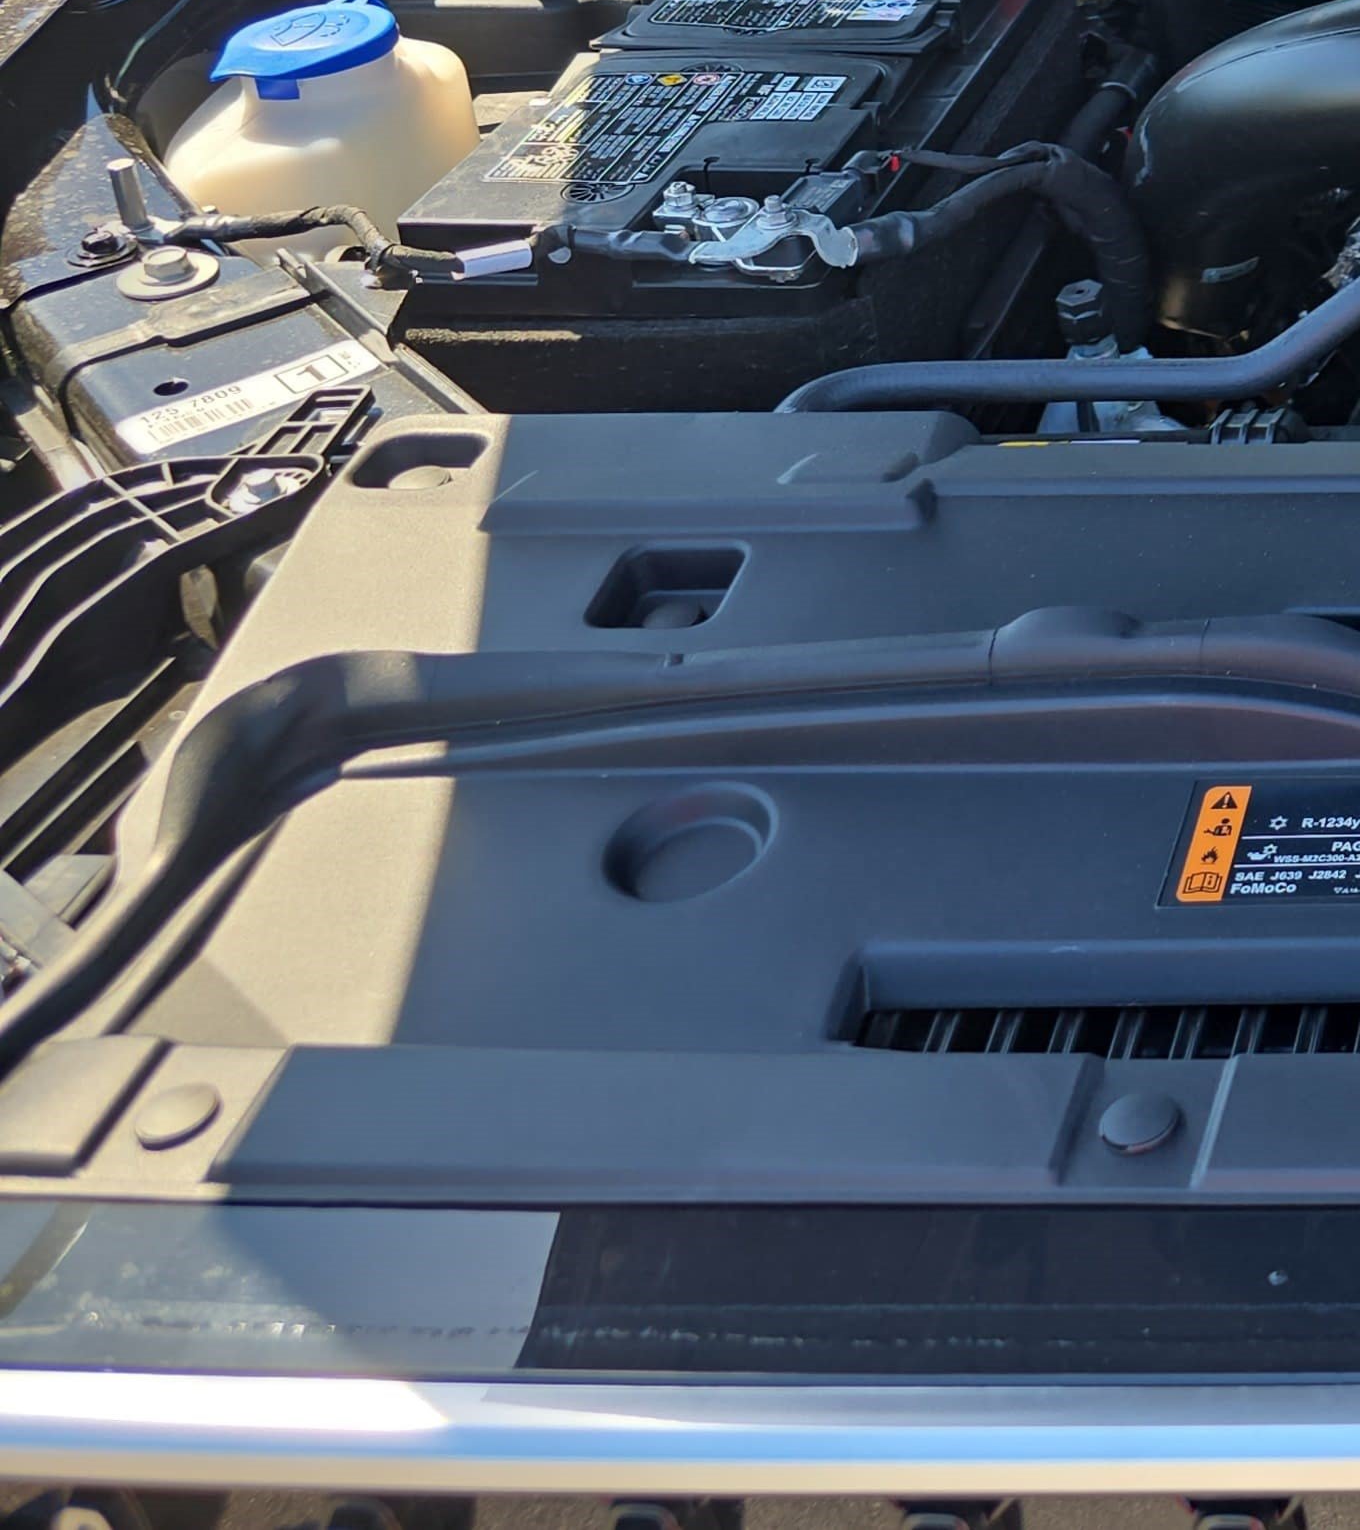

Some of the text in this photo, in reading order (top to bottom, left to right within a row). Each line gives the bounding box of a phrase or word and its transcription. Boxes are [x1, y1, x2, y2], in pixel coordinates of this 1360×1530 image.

[297, 364, 327, 382] 1
[140, 407, 179, 423] 125
[1234, 871, 1264, 882] SAE
[1230, 882, 1298, 895] FoMoCo
